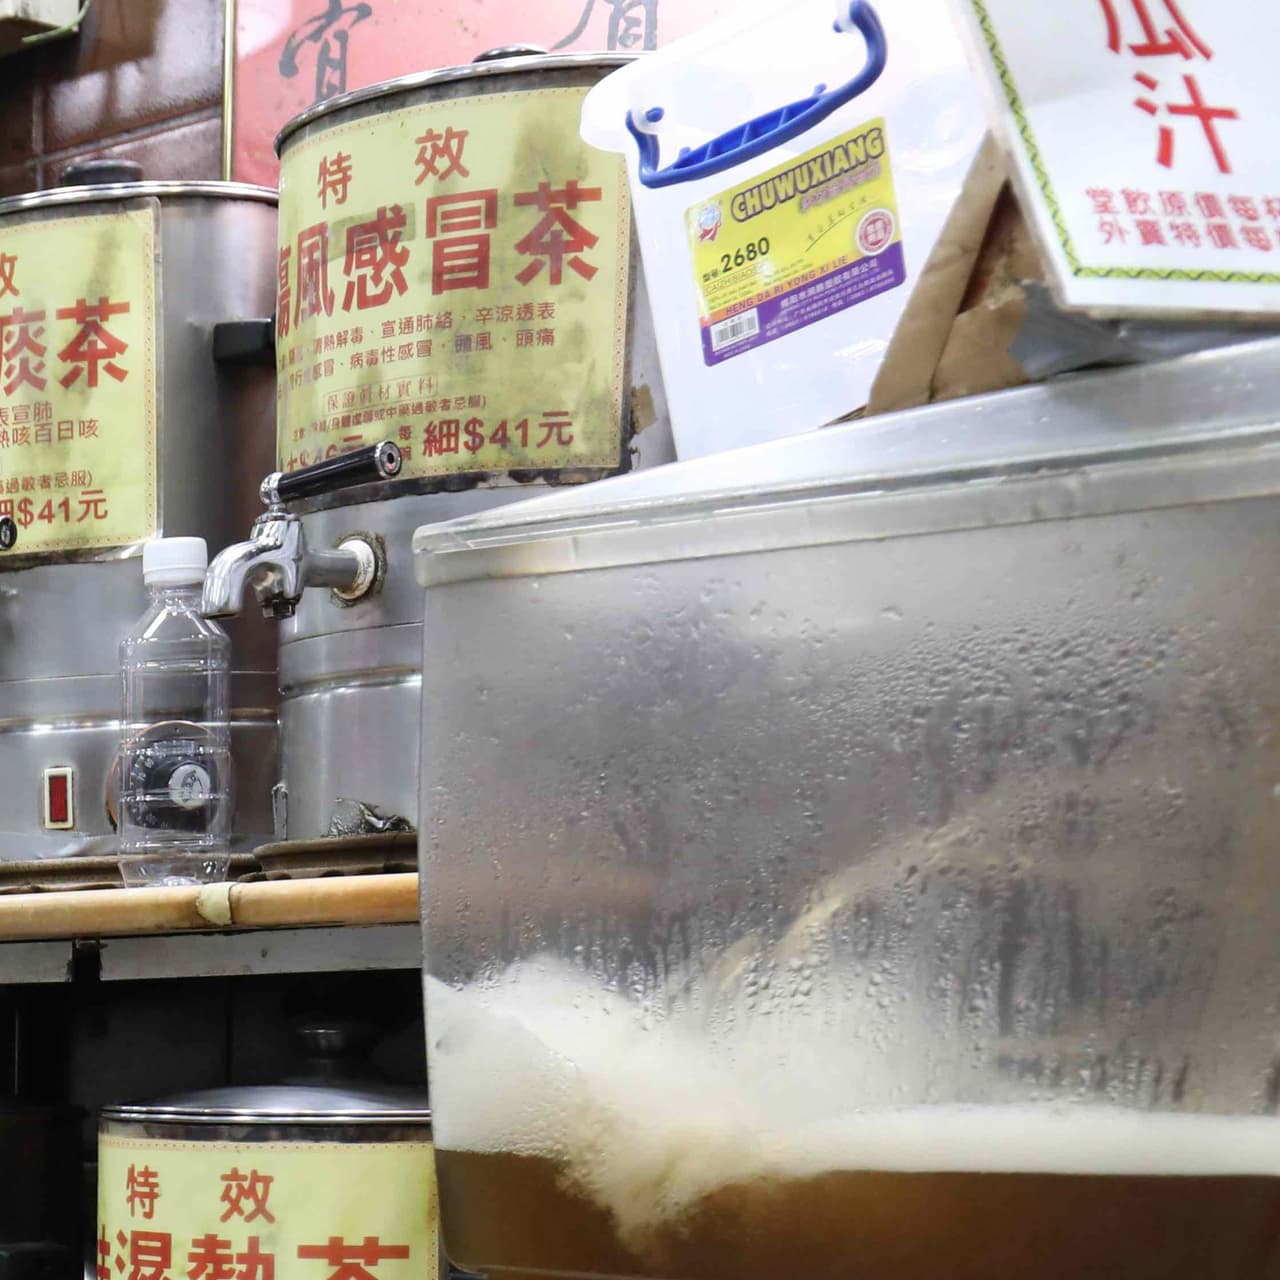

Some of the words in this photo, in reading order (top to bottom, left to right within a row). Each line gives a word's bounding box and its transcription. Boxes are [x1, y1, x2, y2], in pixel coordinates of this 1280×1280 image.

[318, 127, 470, 210] 特效
[731, 127, 885, 223] CHUWUXIANG
[720, 237, 771, 274] 2680
[1099, 216, 1280, 252] 外賣特價每
[726, 299, 754, 316] HENG
[422, 411, 573, 458] 細$41元
[126, 1164, 276, 1225] 特效
